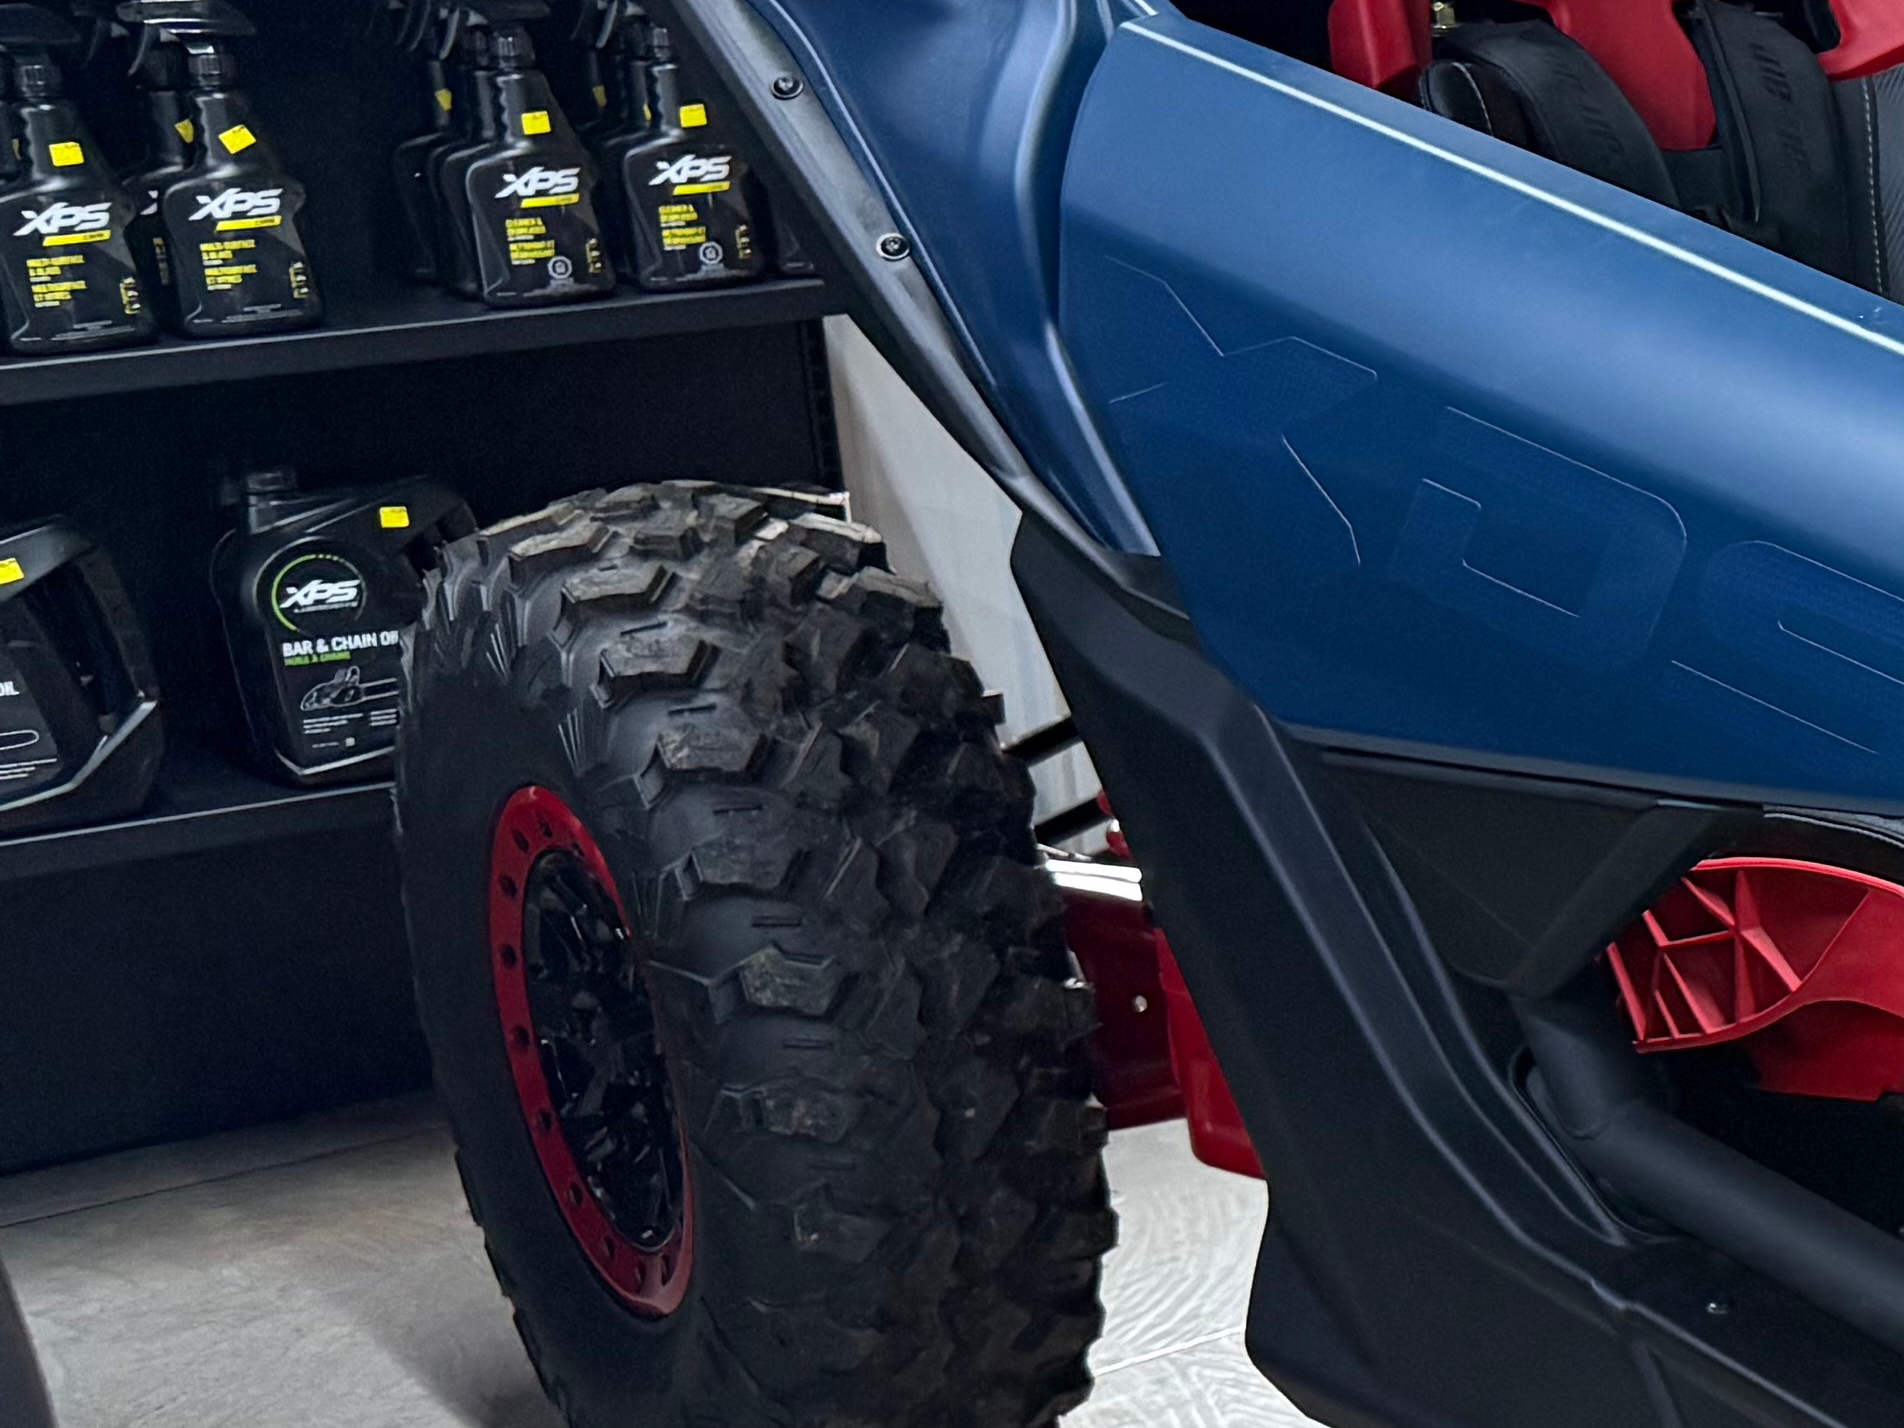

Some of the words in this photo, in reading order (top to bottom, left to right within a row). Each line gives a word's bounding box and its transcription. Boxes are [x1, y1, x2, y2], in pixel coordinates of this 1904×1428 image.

[494, 166, 581, 199] XPS
[648, 154, 733, 186] XPS
[12, 201, 113, 237] XPS
[188, 187, 284, 221] XPS
[279, 578, 361, 609] XPS
[282, 640, 314, 657] BAR
[315, 638, 329, 654] &
[331, 632, 378, 652] CHAIN
